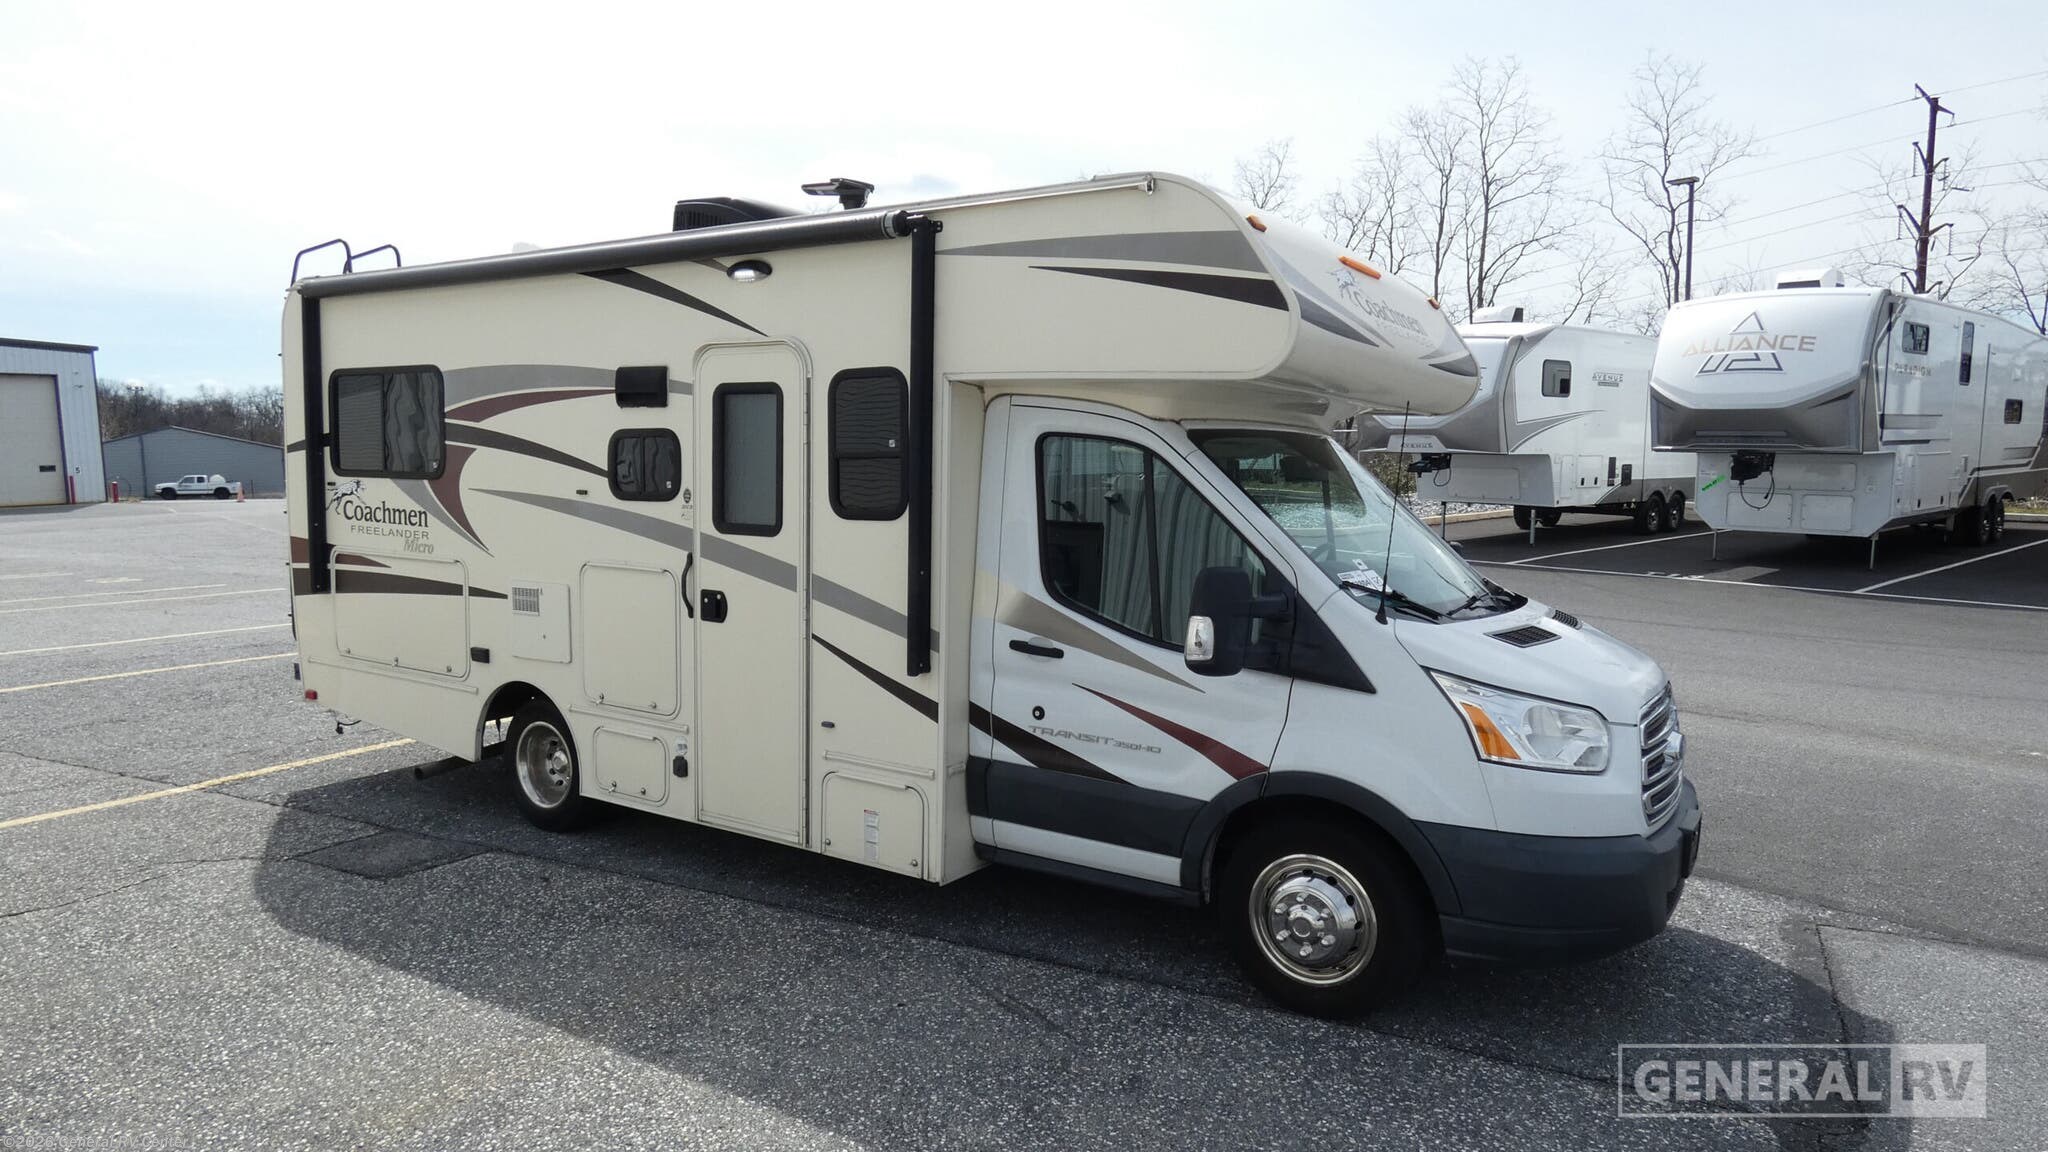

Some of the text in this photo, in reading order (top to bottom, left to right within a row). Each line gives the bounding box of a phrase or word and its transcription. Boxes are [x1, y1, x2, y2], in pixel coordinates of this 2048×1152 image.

[1681, 335, 1817, 357] ALLIANCE
[1592, 372, 1624, 383] AVENUE
[343, 500, 429, 528] Coachmen
[350, 525, 430, 540] FREELANDER
[403, 539, 434, 554] Micro
